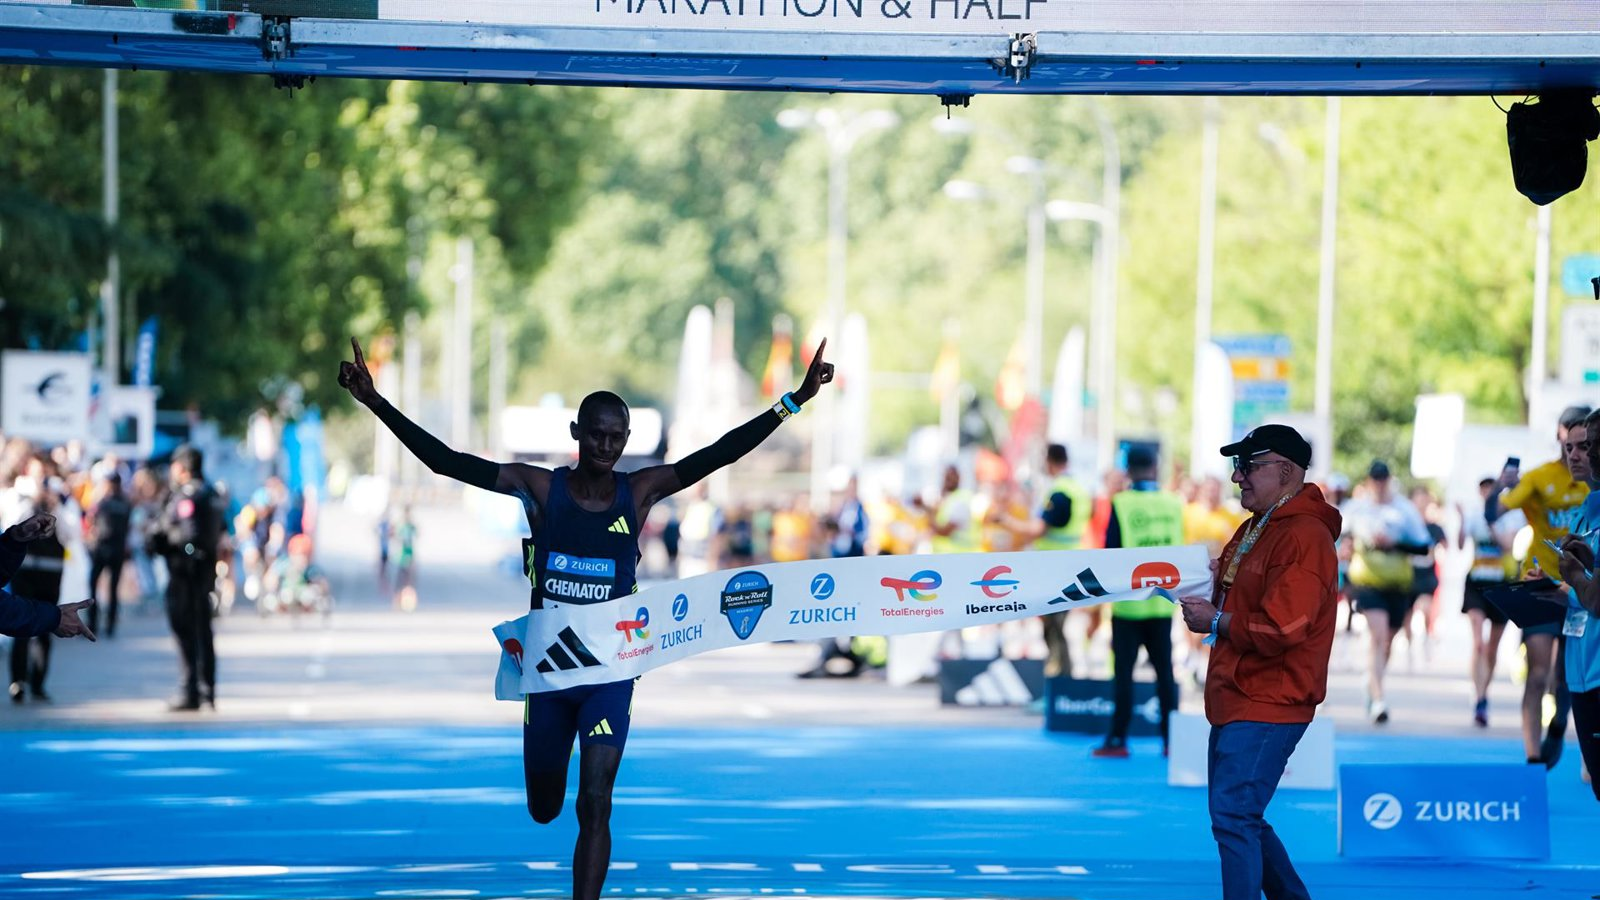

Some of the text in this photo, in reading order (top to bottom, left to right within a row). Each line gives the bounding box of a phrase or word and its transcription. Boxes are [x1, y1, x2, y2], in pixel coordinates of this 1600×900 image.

[571, 560, 608, 572] ZURICH
[545, 578, 611, 600] CHEMATOT
[725, 594, 744, 603] Rock
[750, 591, 768, 599] Roll
[789, 607, 856, 625] ZURICH
[880, 607, 944, 618] TotalEnergies
[965, 601, 1028, 615] Ibercaja
[660, 623, 703, 650] ZURICH
[1415, 801, 1521, 822] ZURICH
